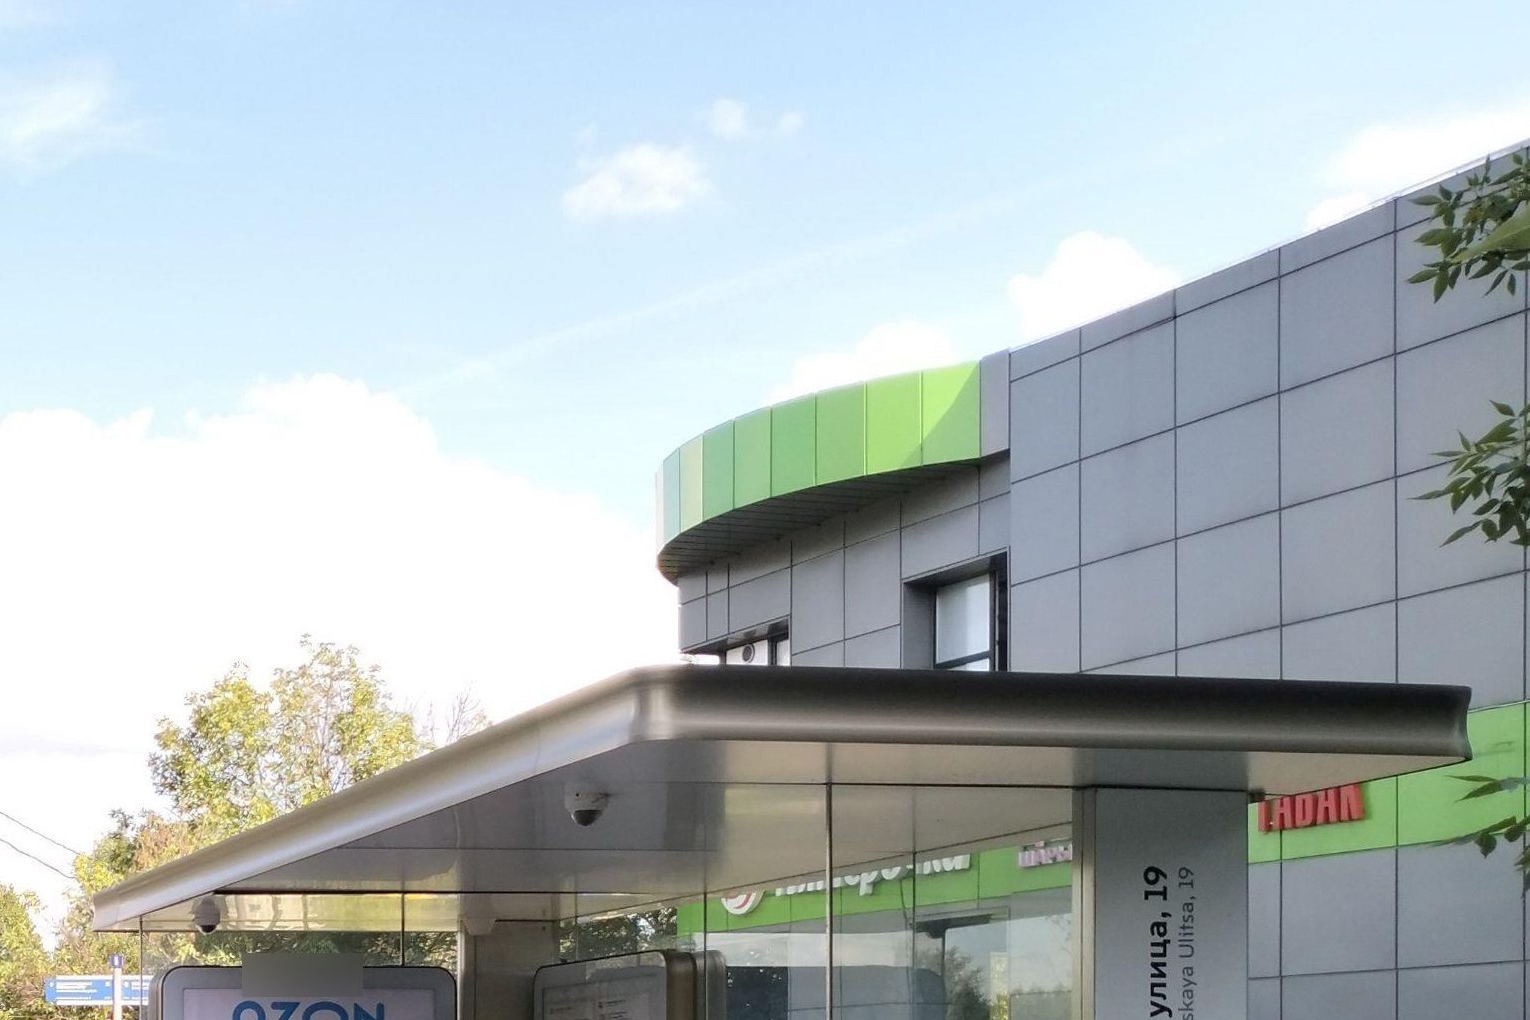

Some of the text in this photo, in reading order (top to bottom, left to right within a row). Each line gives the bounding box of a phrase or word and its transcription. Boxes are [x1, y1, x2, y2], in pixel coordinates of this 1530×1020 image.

[1143, 866, 1168, 901] 19
[1178, 866, 1194, 888] 19
[1178, 894, 1197, 958] Ulitsa,
[1148, 912, 1172, 1018] улица,
